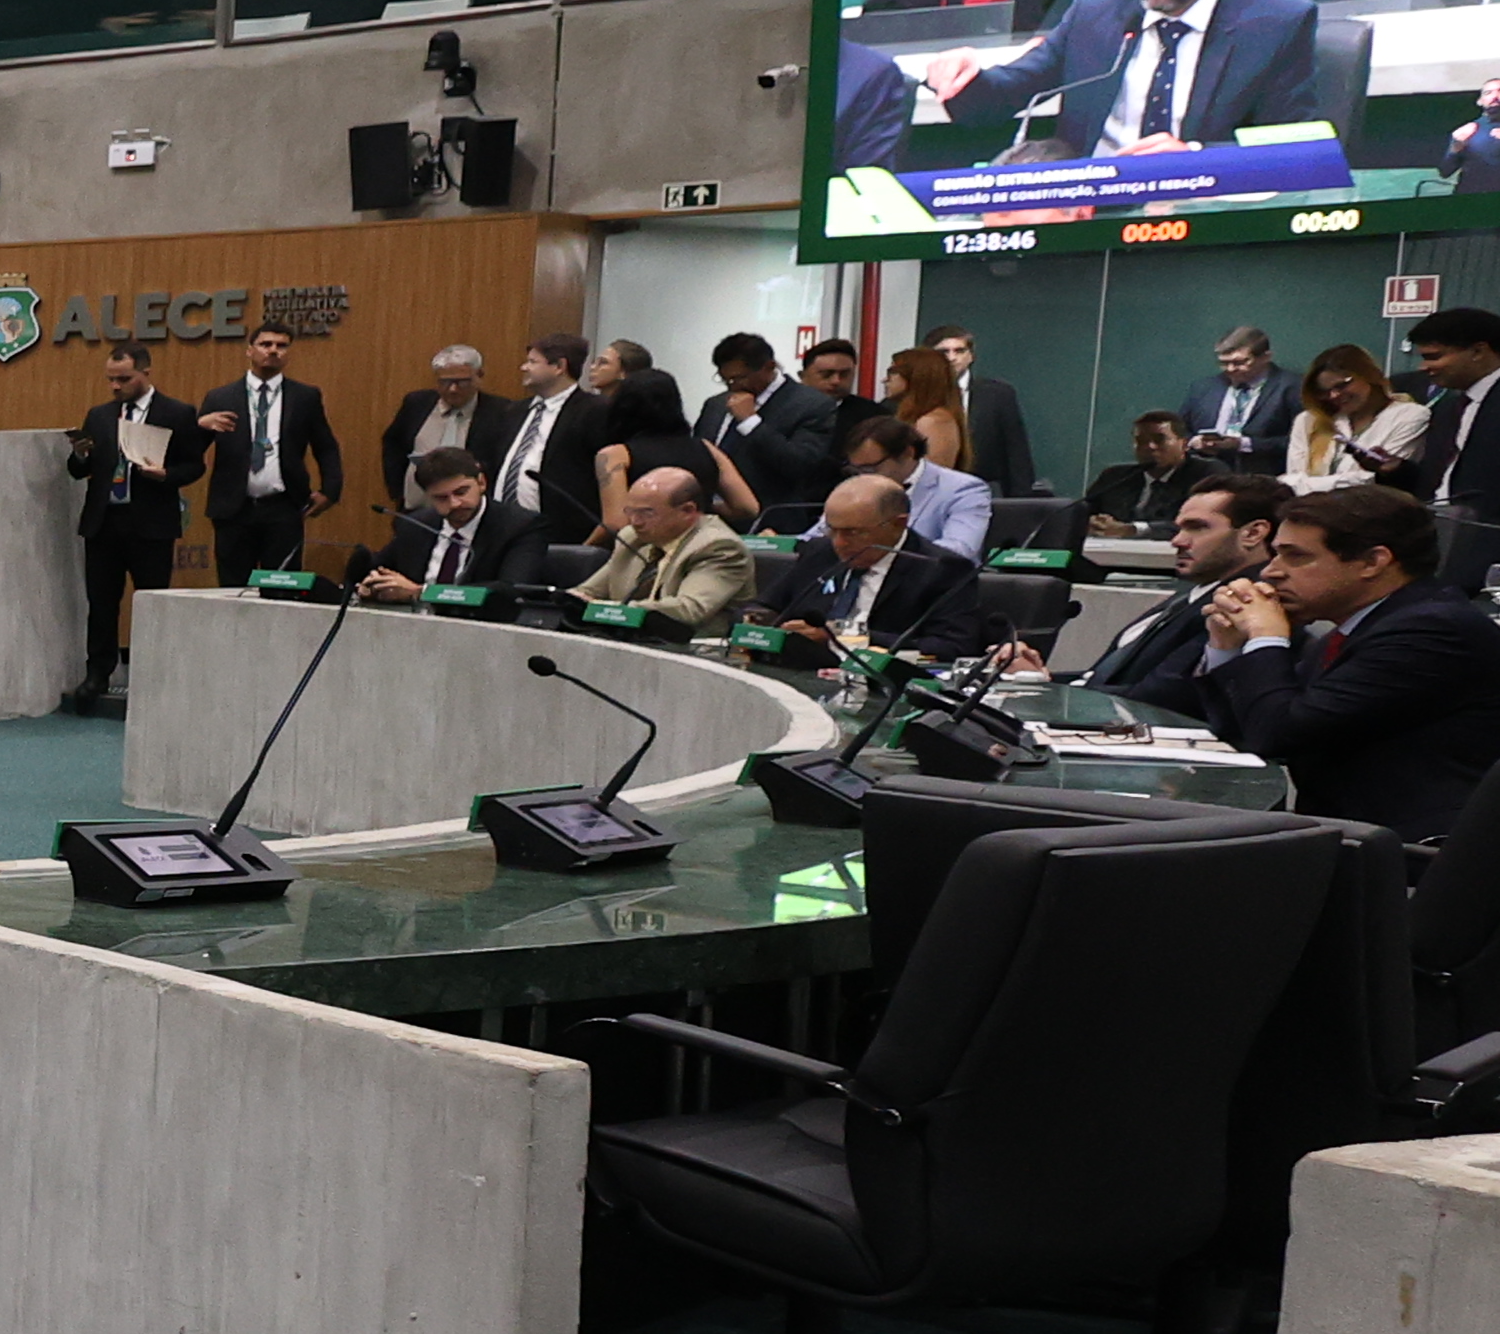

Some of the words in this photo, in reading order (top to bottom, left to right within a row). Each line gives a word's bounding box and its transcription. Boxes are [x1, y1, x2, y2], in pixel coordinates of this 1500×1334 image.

[943, 230, 1036, 254] 12:38:46
[1122, 220, 1190, 243] 00:00
[1291, 209, 1360, 234] 00:00
[53, 289, 248, 343] ALECE
